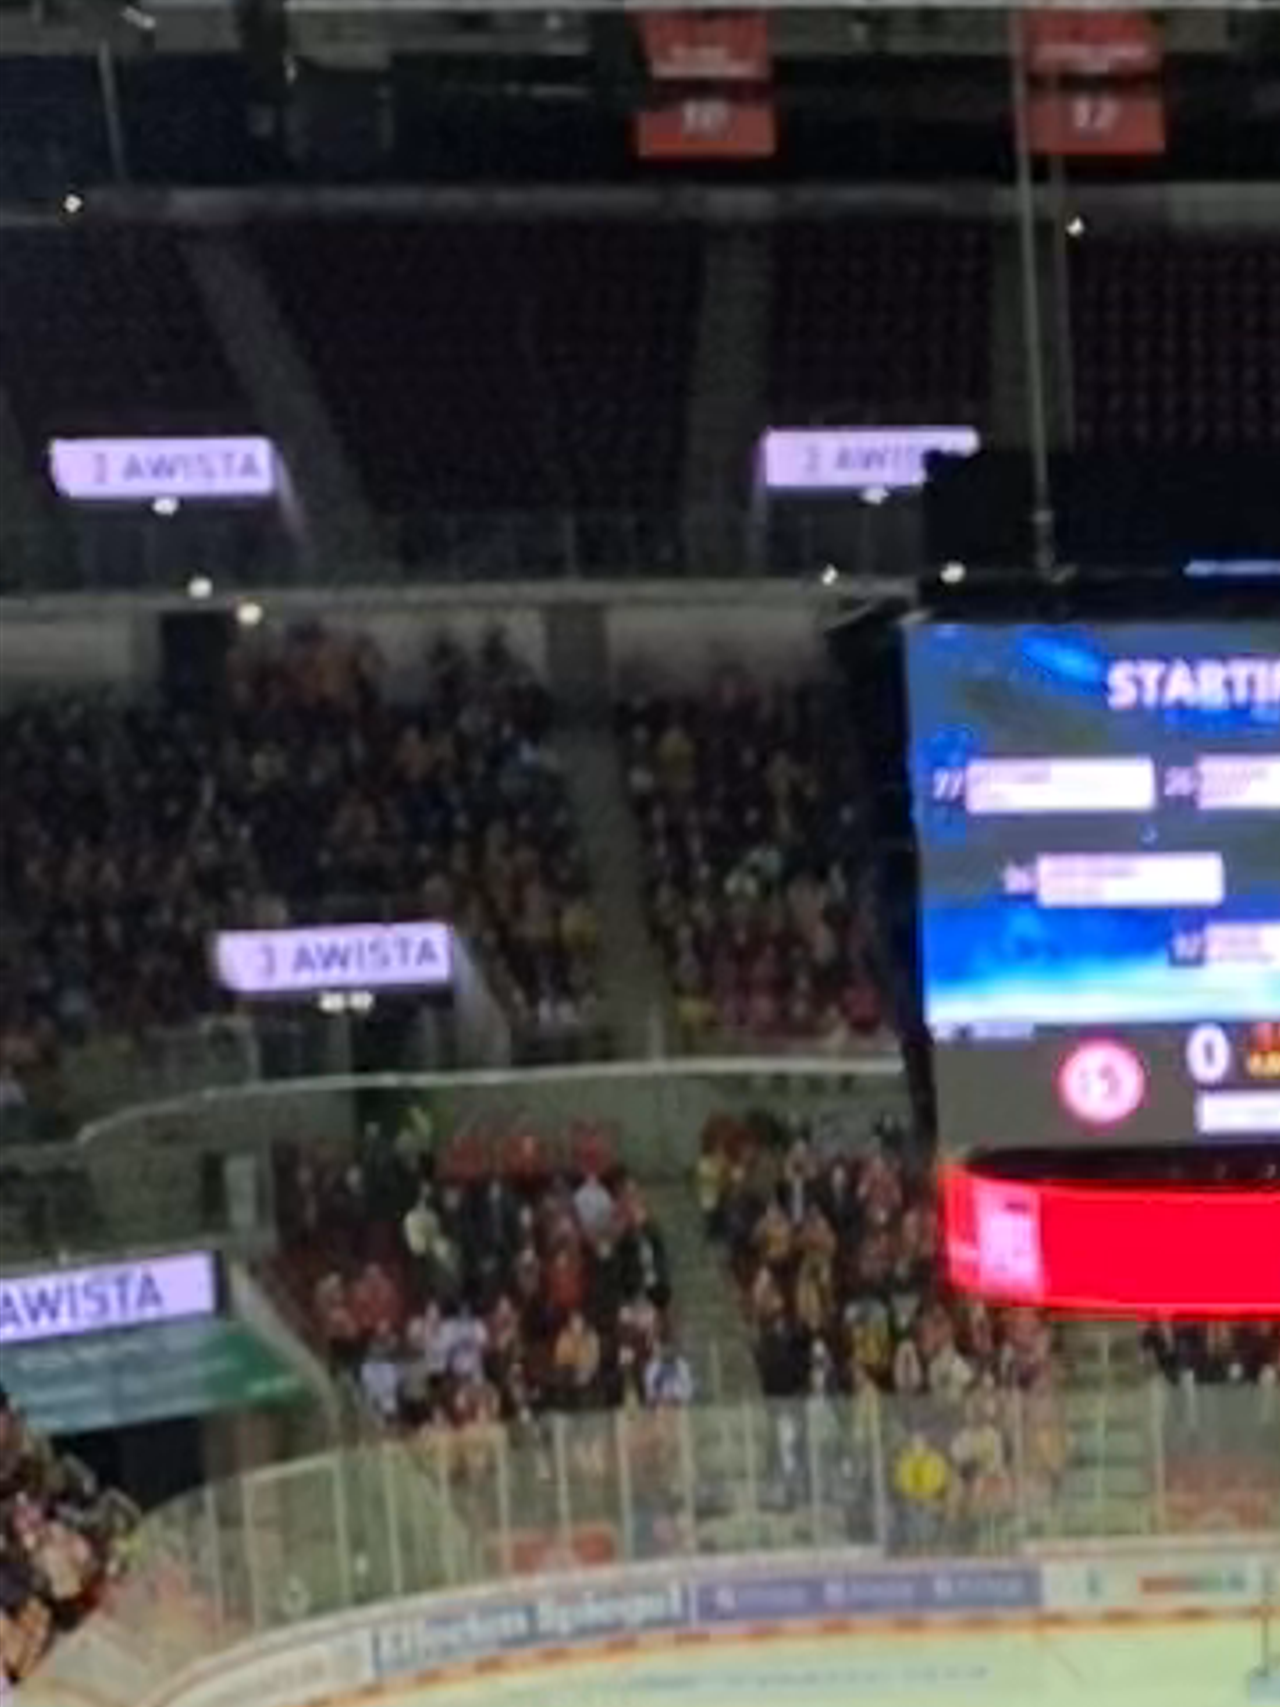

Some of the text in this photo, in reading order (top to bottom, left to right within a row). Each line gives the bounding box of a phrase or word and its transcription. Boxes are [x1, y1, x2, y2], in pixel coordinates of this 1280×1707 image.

[122, 451, 261, 482] AWISTA
[292, 937, 439, 974] AWISTA
[1186, 1024, 1231, 1084] 0
[0, 1267, 163, 1327] AWISTA
